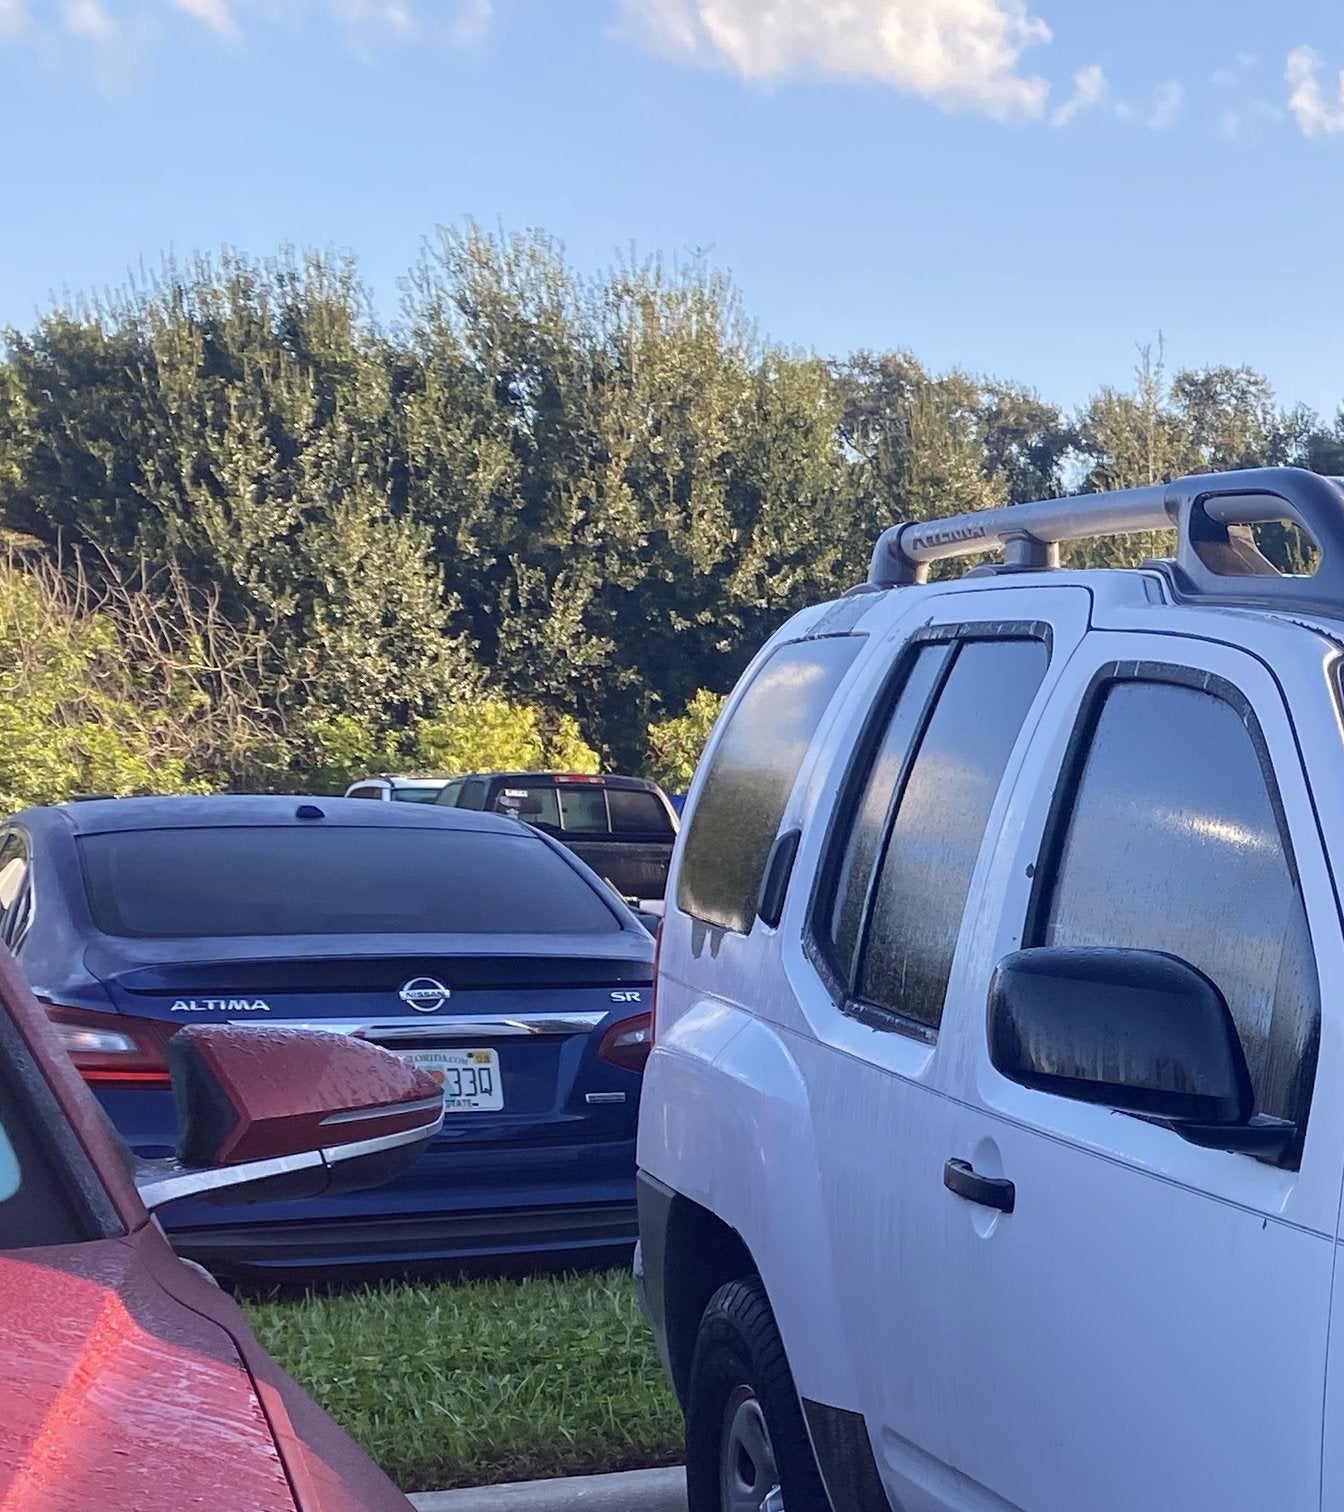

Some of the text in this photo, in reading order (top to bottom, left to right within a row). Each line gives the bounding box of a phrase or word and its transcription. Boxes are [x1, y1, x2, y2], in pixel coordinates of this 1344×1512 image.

[611, 991, 641, 1002] SR
[170, 999, 270, 1012] ALTIMA
[447, 1067, 492, 1096] 33Q
